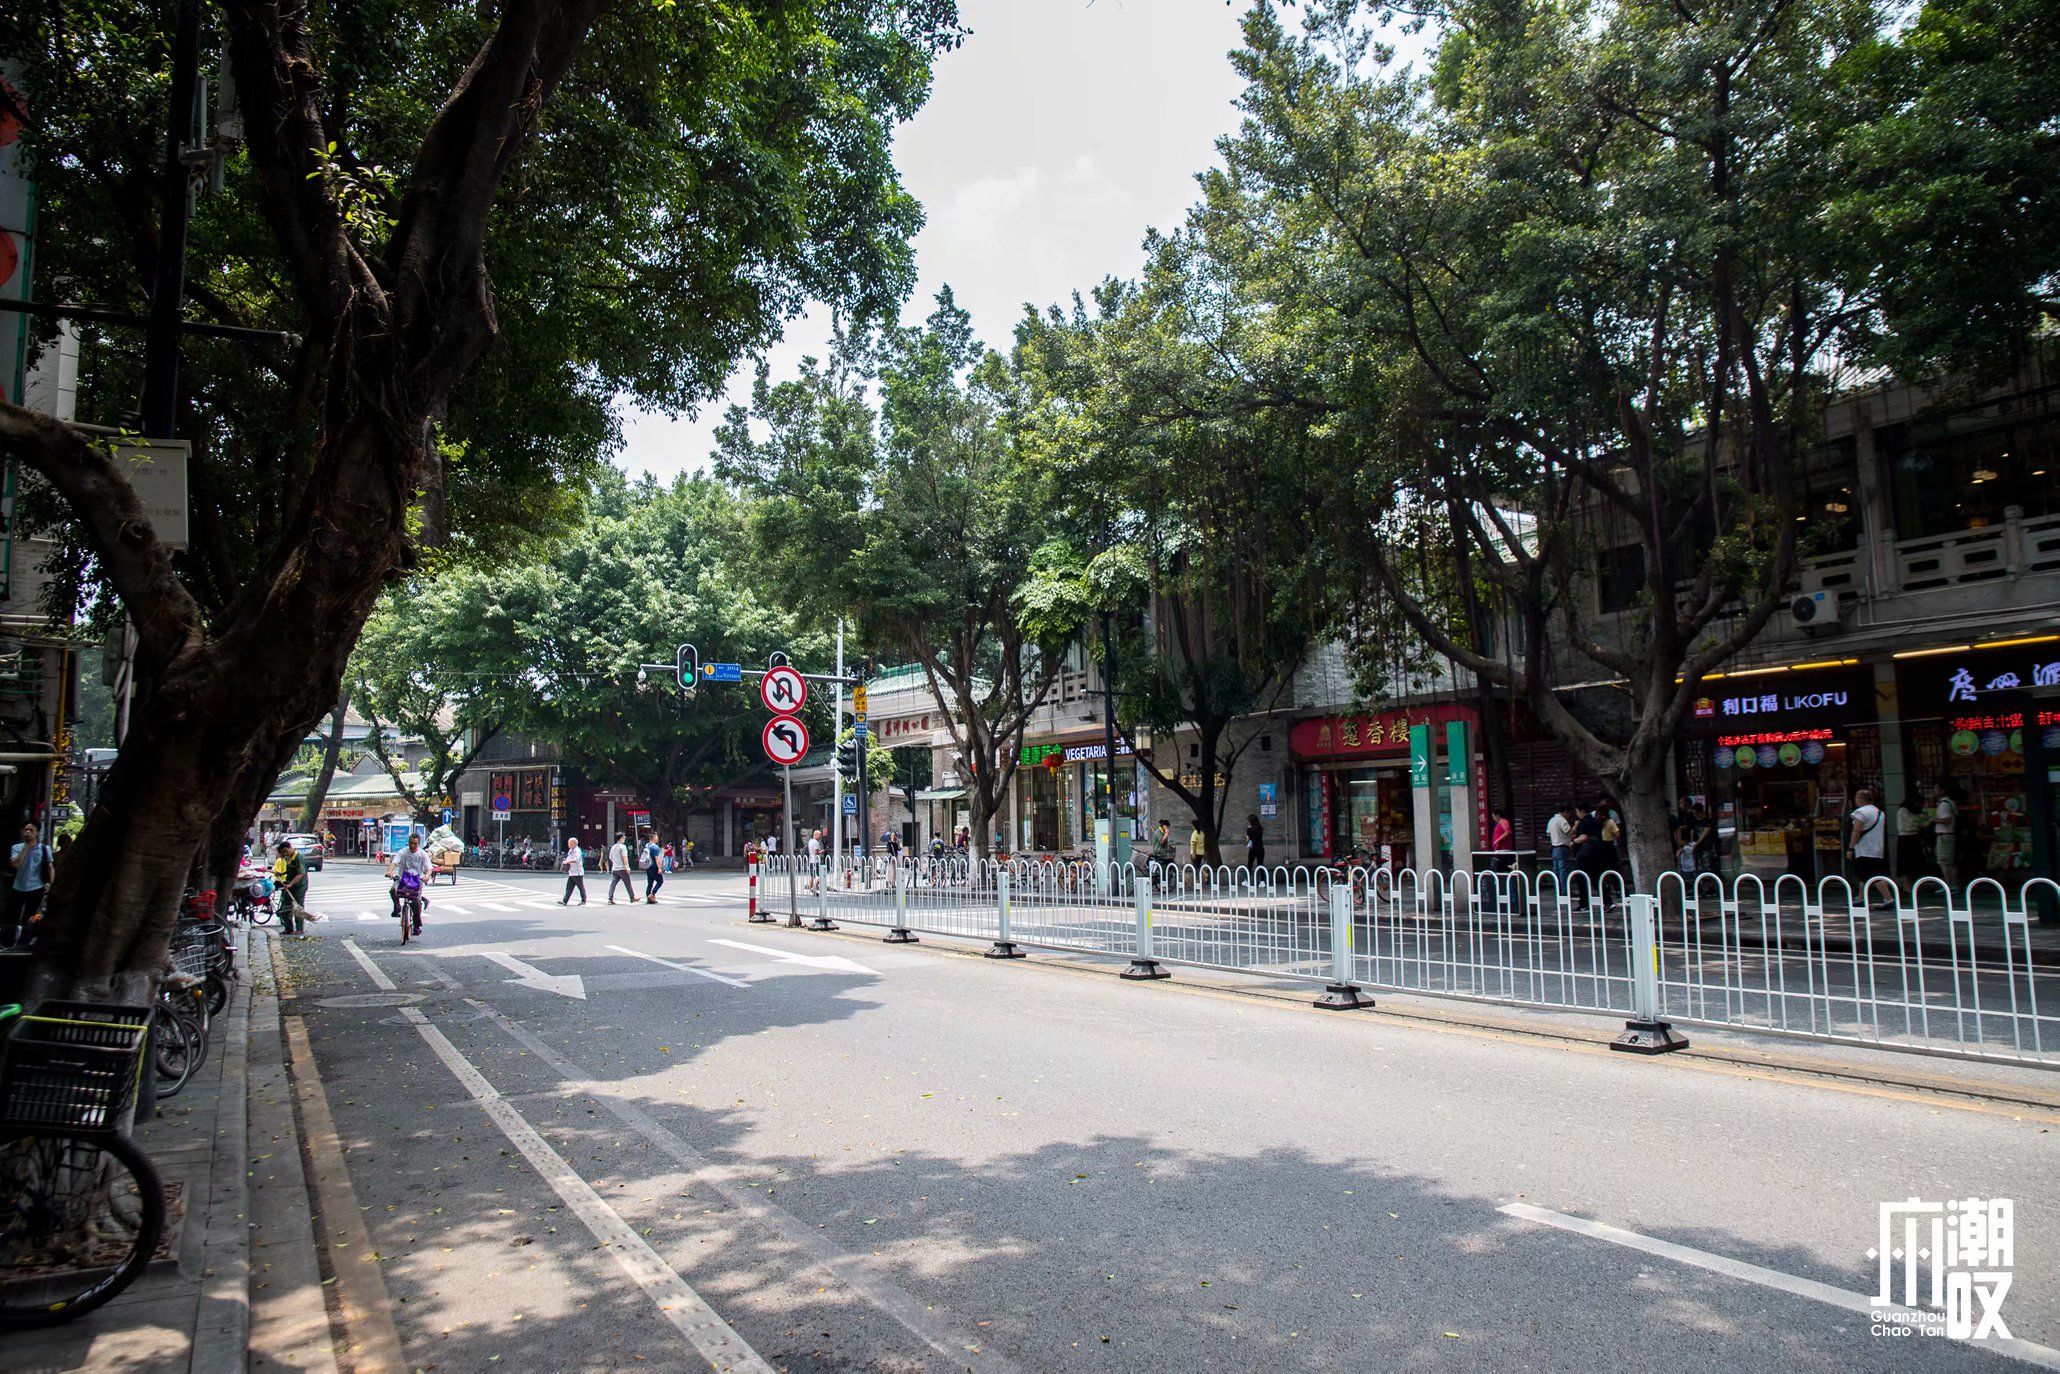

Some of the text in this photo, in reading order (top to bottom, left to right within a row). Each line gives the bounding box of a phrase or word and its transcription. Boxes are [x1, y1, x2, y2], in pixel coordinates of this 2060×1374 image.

[1722, 694, 1778, 716] 利口福
[1784, 691, 1847, 710] LIKOFU
[1065, 745, 1107, 761] VEGETARIA
